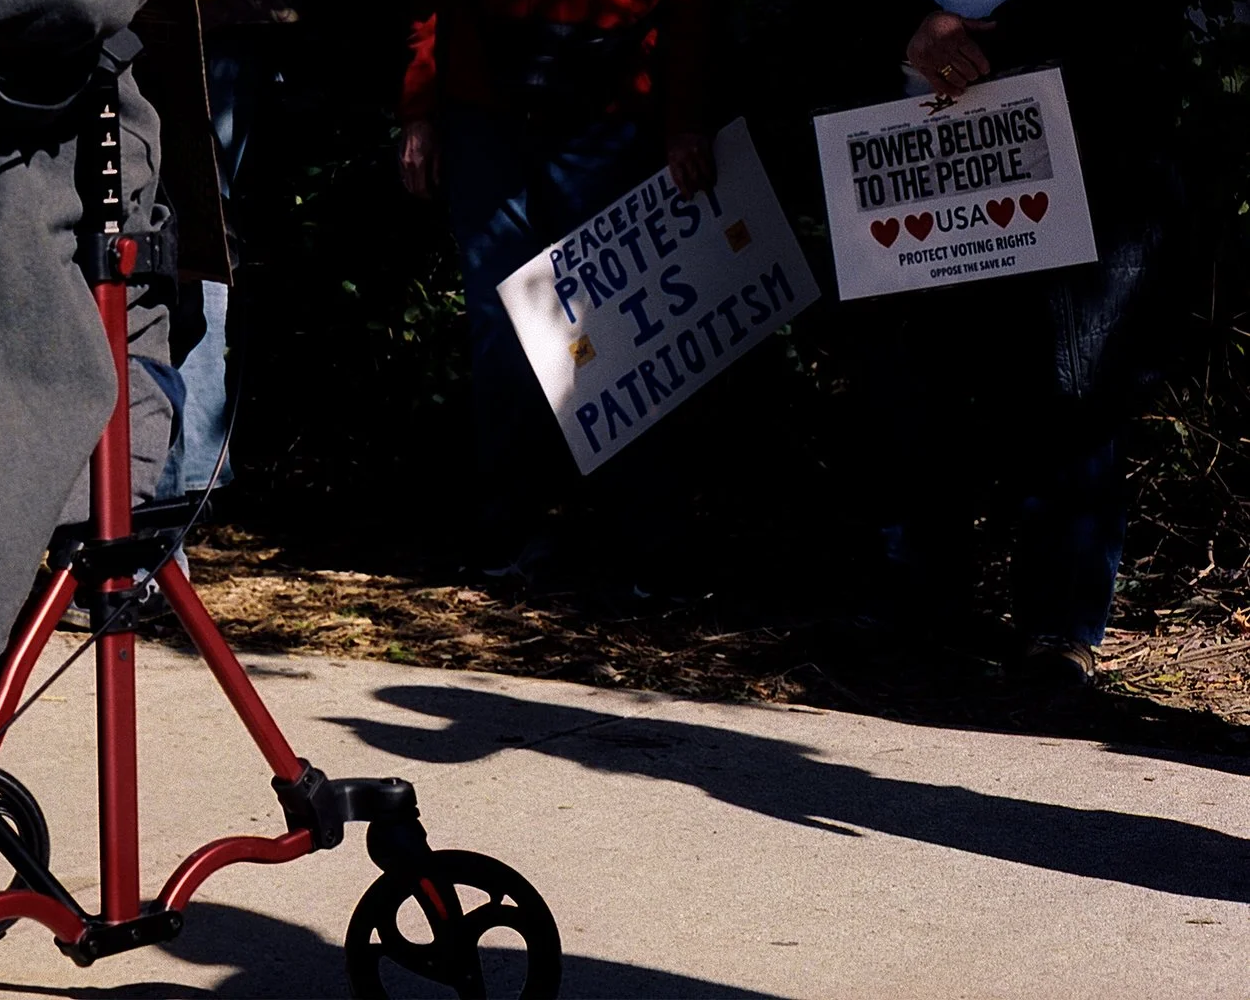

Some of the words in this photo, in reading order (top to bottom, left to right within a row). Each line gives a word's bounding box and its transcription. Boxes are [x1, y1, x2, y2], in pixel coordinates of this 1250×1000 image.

[850, 127, 934, 173] POWER
[937, 106, 1043, 157] BELONGS
[853, 174, 886, 208] TO
[888, 166, 934, 203] THE
[935, 148, 1032, 194] PEOPLE.
[549, 175, 678, 278] PEACEFUL
[898, 245, 949, 267] PROTECT
[950, 238, 994, 259] VOTING
[995, 231, 1037, 251] RIGHTS
[935, 203, 988, 233] USA
[930, 263, 963, 279] OPPOSE
[963, 262, 978, 274] THE
[979, 259, 1000, 272] SAVE
[1001, 256, 1016, 269] ACT
[618, 264, 699, 348] IS
[575, 262, 795, 454] PATRIOTISM
